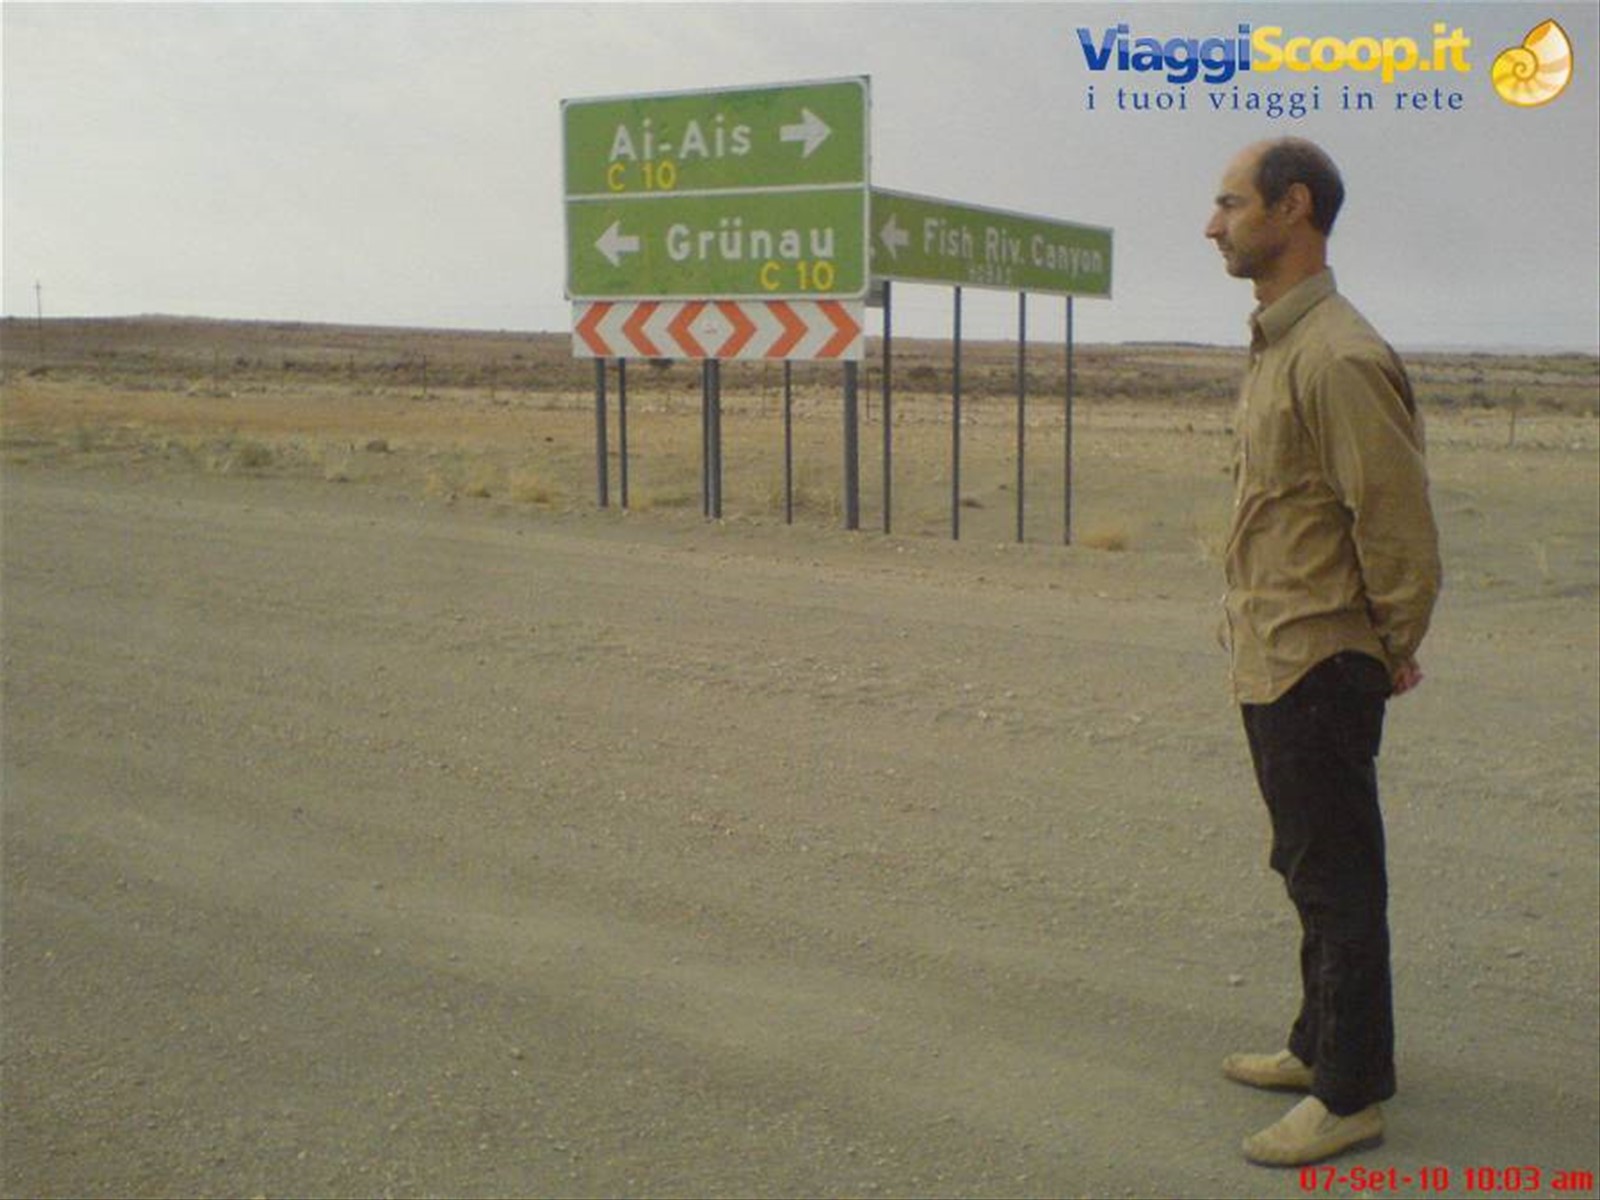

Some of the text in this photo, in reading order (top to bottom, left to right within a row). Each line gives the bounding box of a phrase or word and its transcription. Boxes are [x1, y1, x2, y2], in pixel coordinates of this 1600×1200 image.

[608, 113, 752, 162] Ai-Ais
[607, 160, 677, 190] C 10
[666, 216, 835, 261] Grünau
[922, 215, 974, 259] Fish
[985, 227, 1026, 266] Riv.
[1031, 234, 1104, 279] Canyon
[760, 261, 835, 290] C 10
